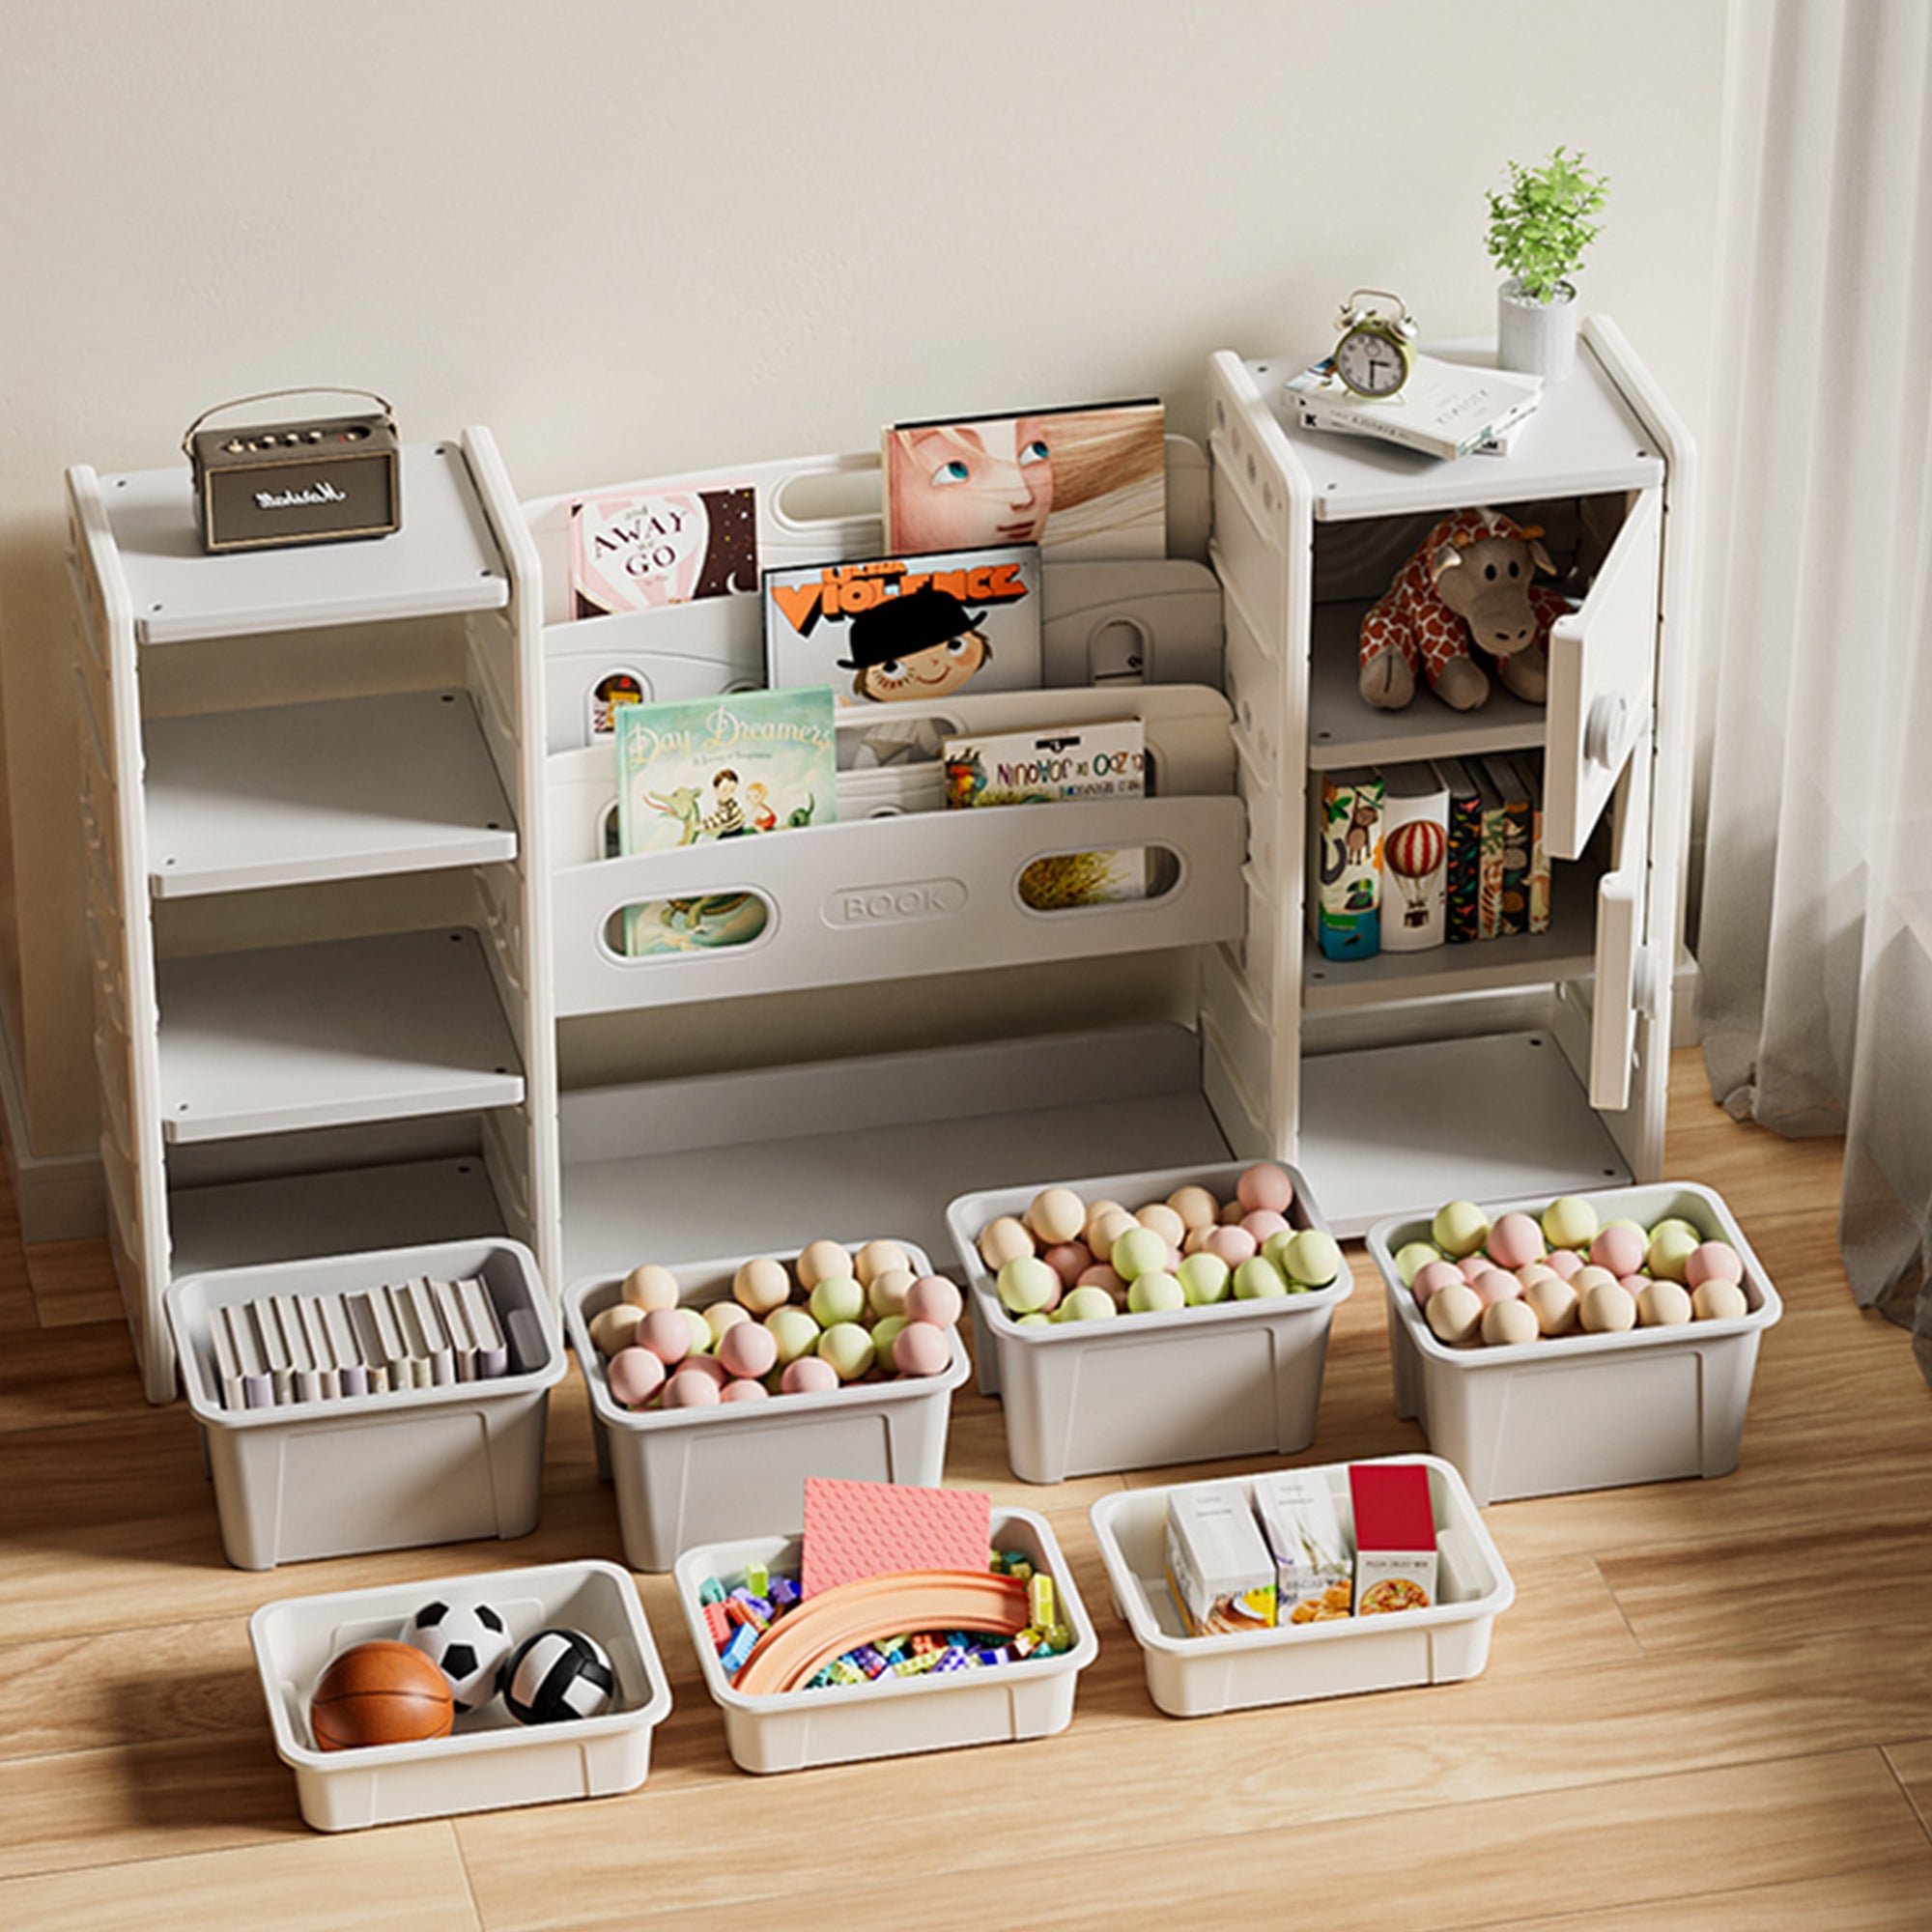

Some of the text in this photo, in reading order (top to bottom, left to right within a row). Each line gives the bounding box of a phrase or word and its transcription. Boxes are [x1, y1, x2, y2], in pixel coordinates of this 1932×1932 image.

[594, 510, 687, 559] AWAY
[626, 545, 676, 576] GO
[628, 705, 832, 769] Day Dreamers
[843, 889, 946, 921] BOOK
